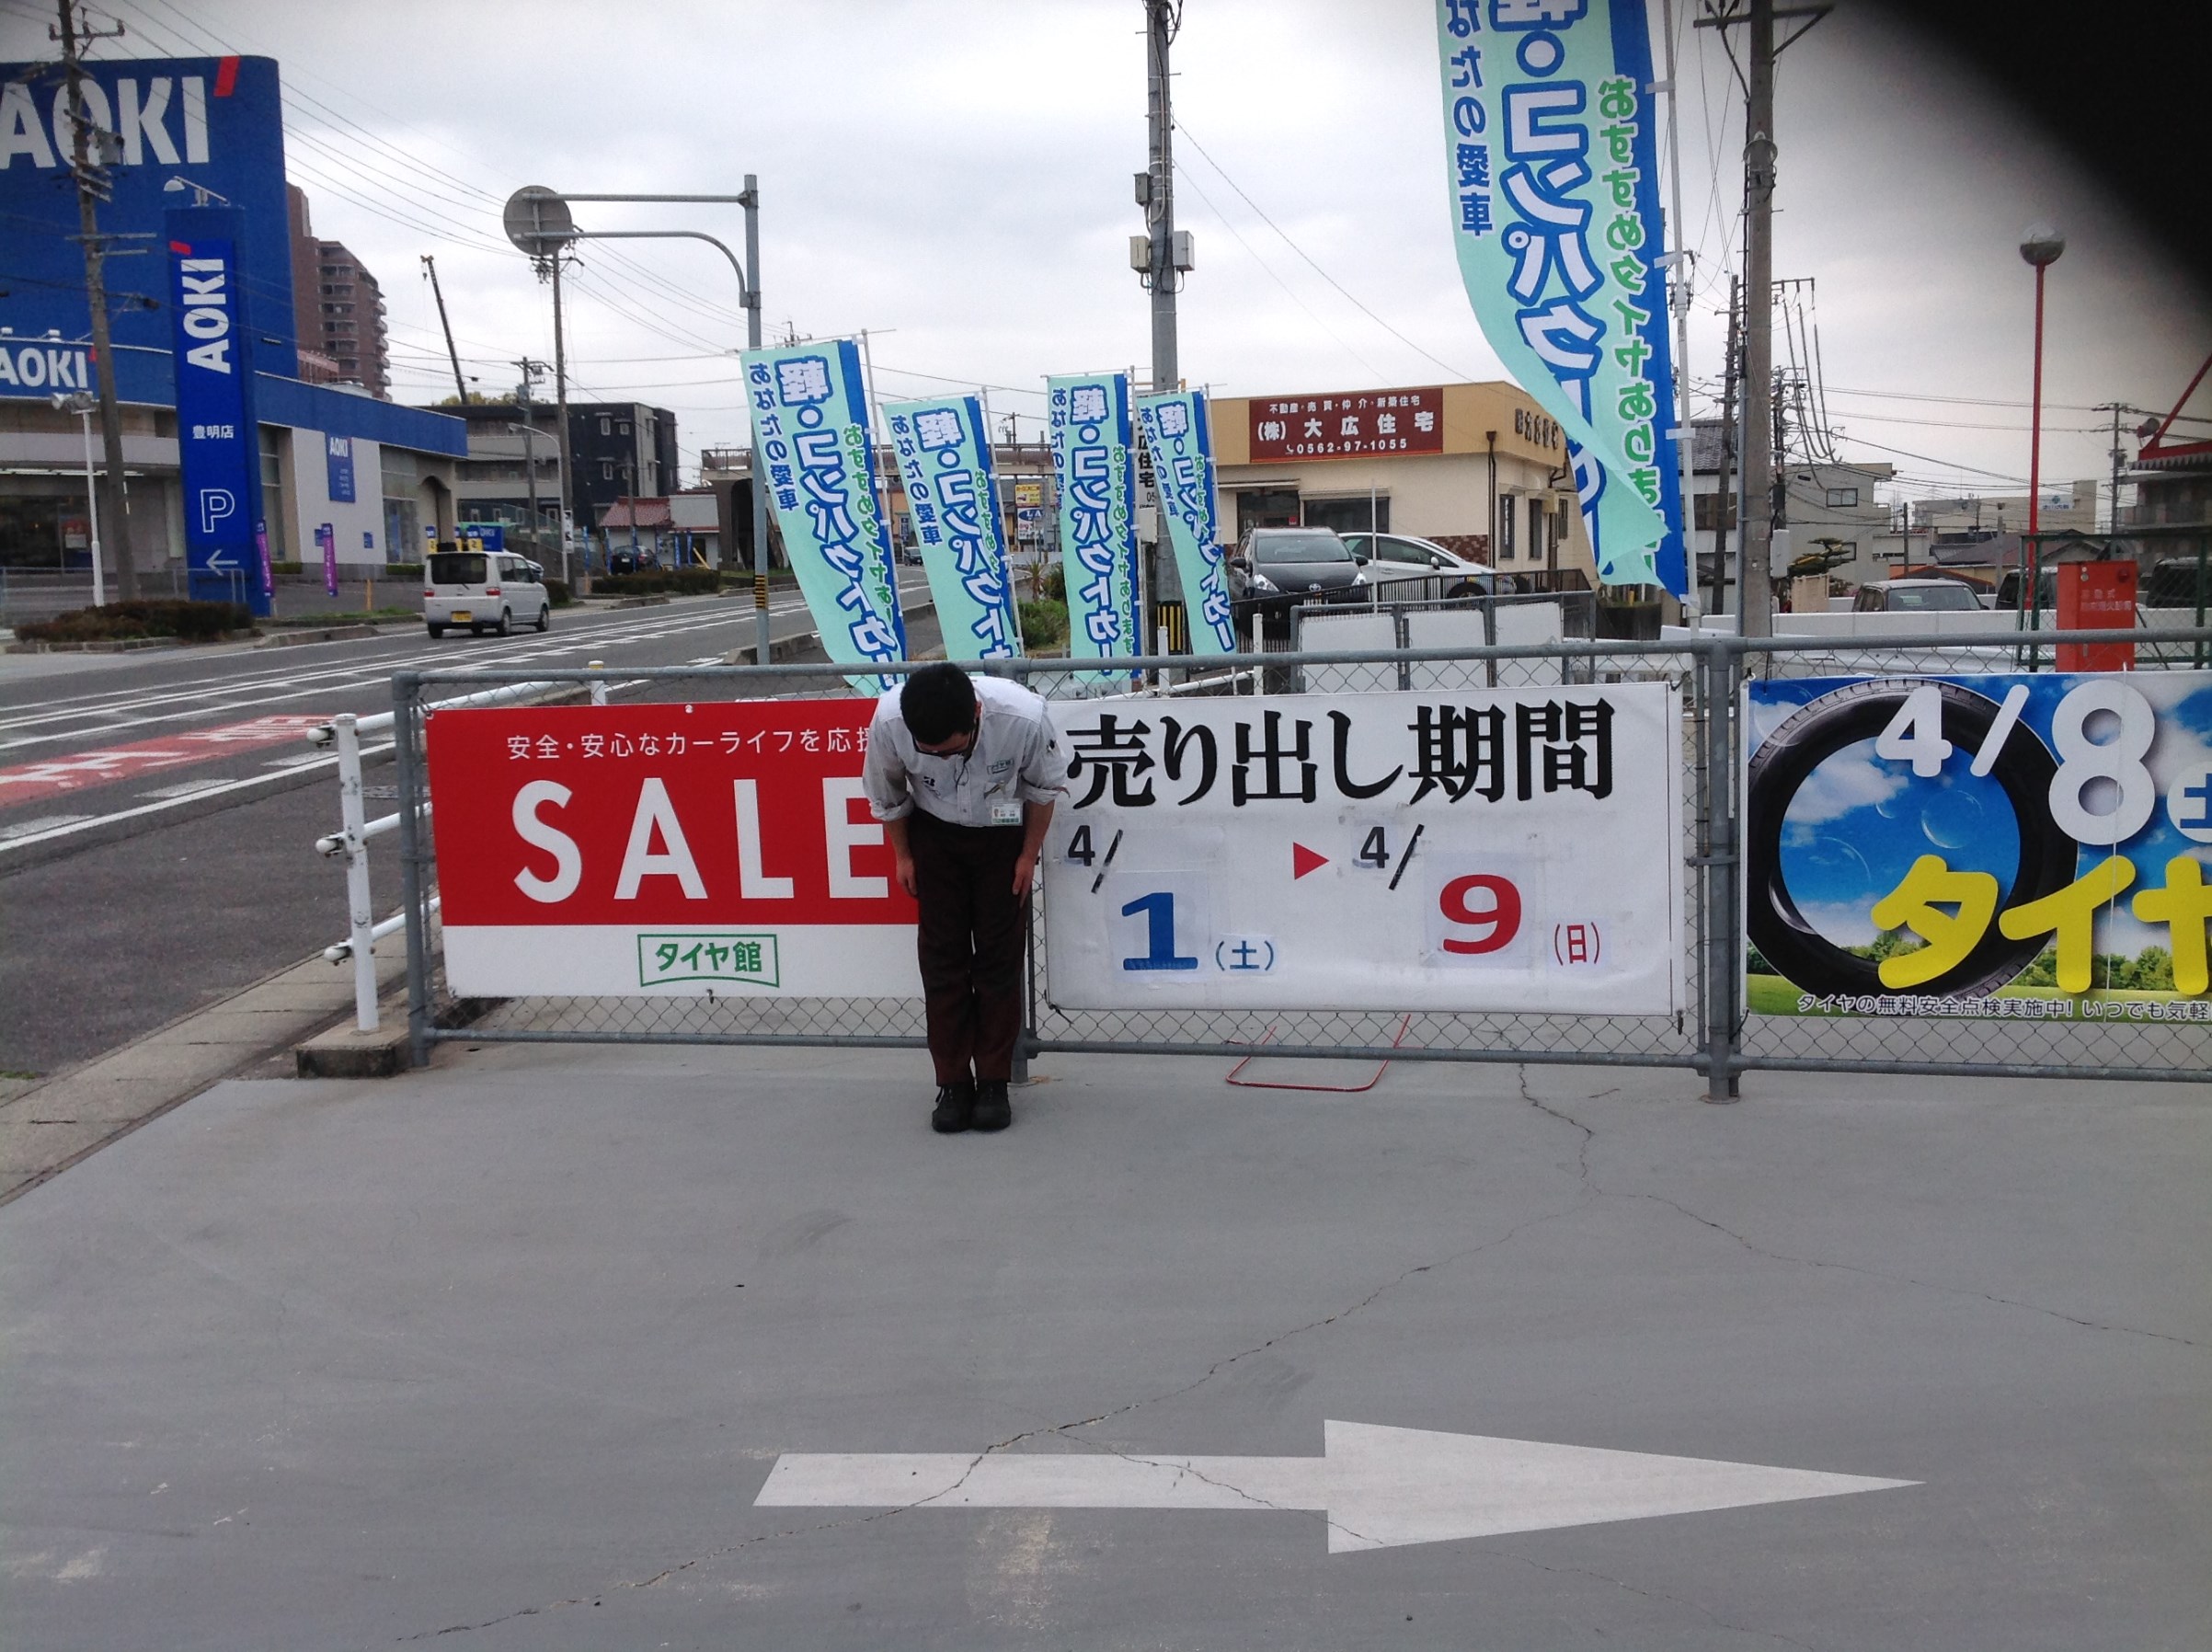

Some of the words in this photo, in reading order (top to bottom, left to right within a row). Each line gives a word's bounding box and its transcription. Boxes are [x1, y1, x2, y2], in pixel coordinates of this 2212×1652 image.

[0, 75, 209, 169] AOKI
[183, 258, 231, 374] AOKI
[192, 425, 235, 440] 豊明店
[200, 488, 235, 533] P
[1066, 697, 1615, 809] 売り出し期間
[511, 776, 889, 903] SALE
[656, 941, 762, 973] タイヤ館
